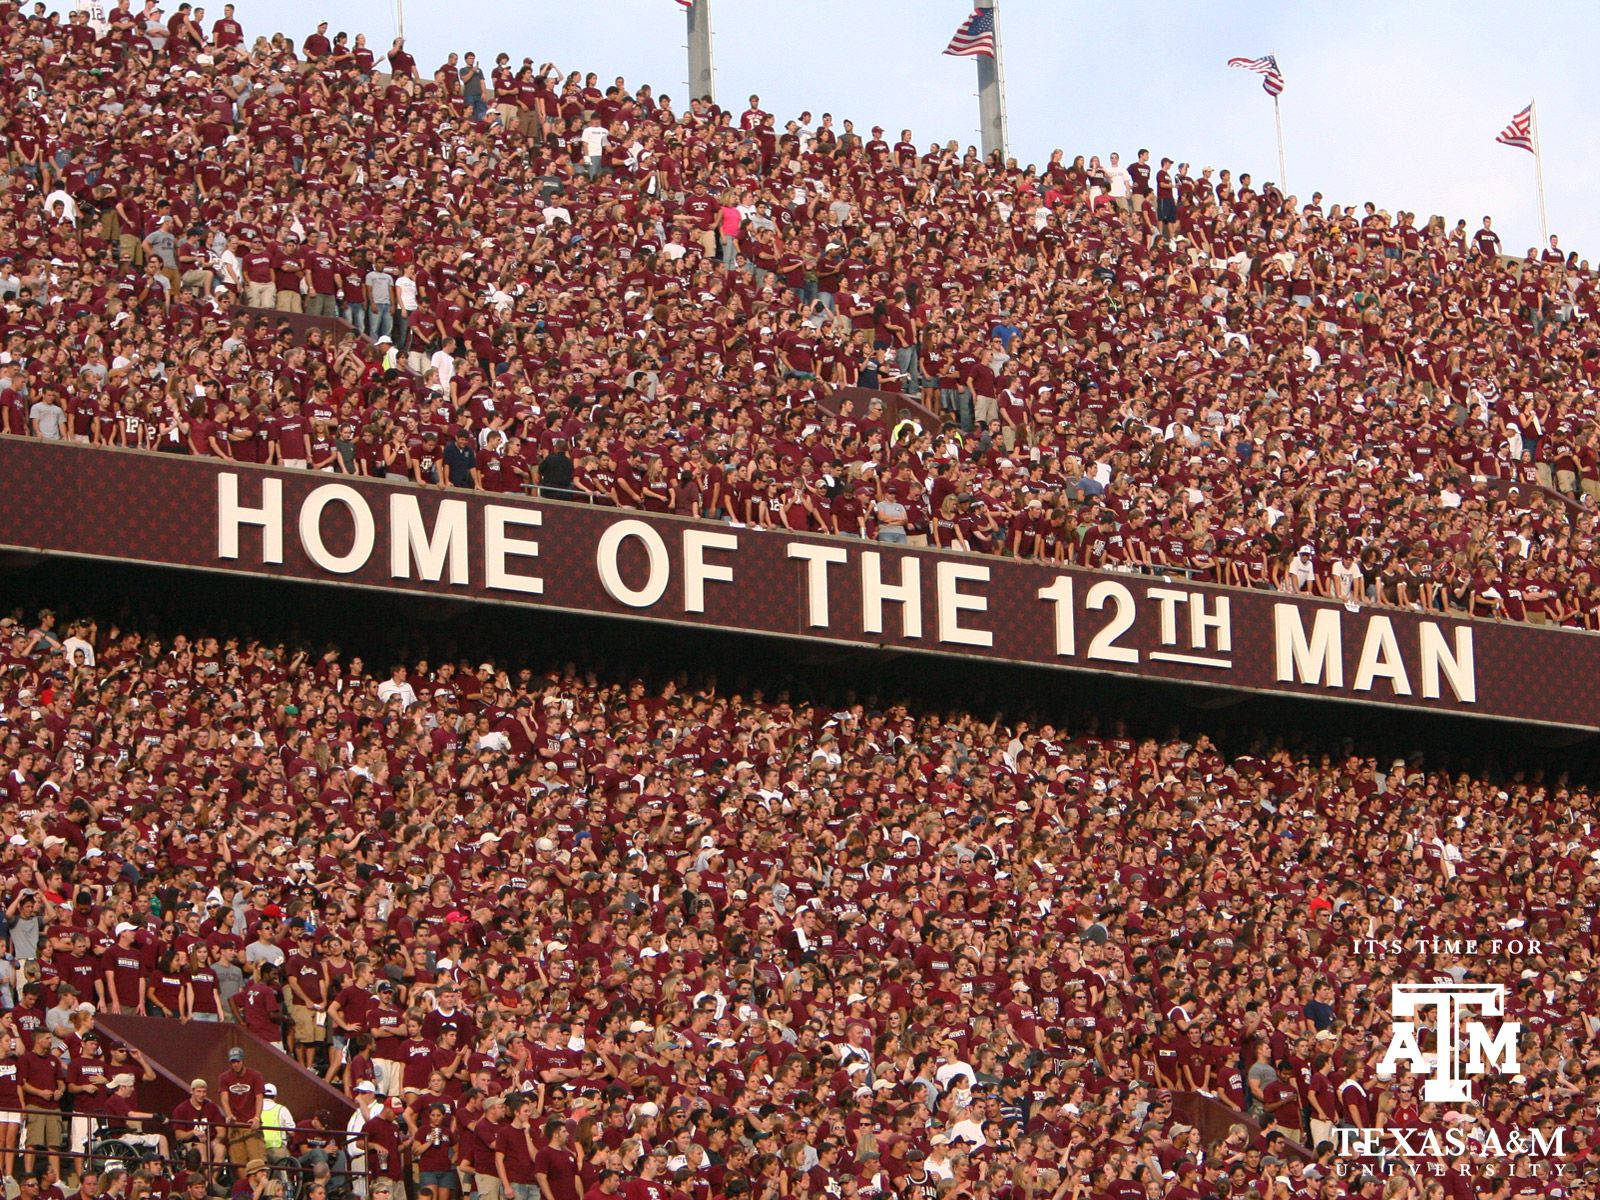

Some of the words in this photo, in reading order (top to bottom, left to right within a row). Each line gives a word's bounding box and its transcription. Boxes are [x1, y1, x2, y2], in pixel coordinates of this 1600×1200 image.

[126, 418, 138, 433] 12
[770, 500, 780, 511] 12
[217, 472, 545, 595] HOME
[596, 519, 739, 613] OF
[787, 542, 994, 648] THE
[1037, 574, 1233, 670] 12TH
[1273, 603, 1477, 703] MAN
